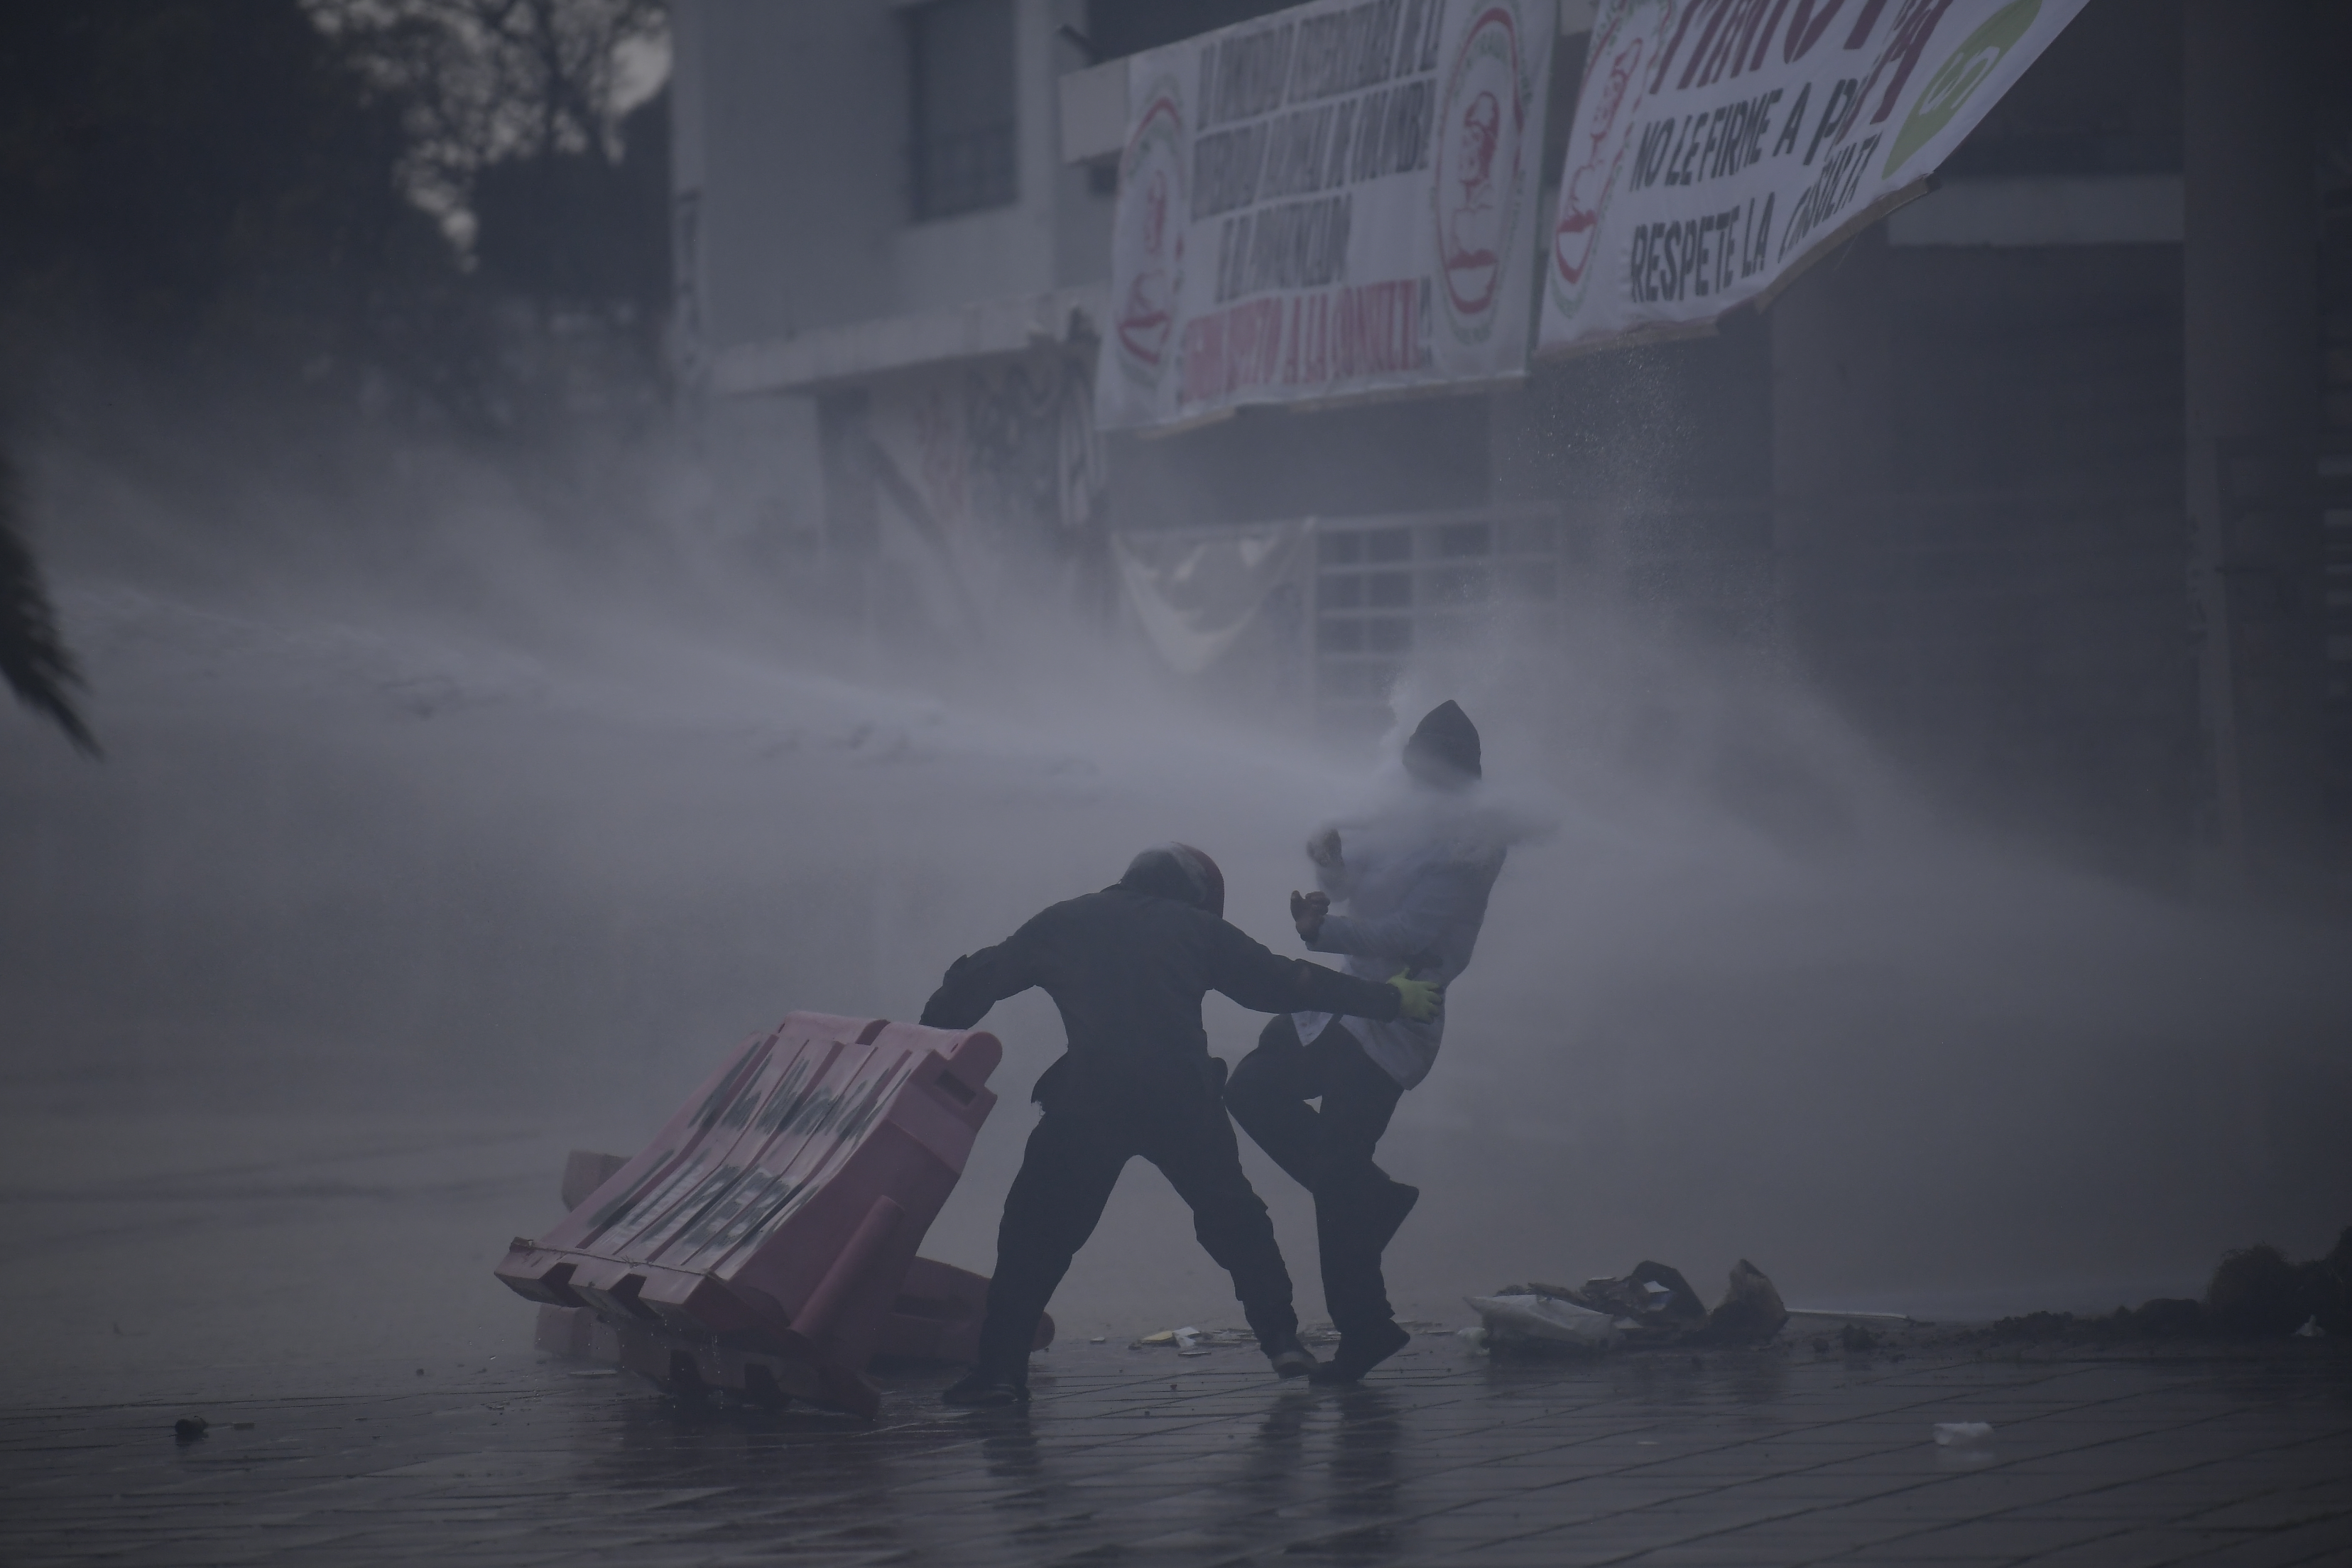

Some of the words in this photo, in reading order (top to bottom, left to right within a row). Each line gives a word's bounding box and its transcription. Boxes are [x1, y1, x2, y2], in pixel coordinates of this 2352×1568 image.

[1628, 117, 1675, 192] NO
[1664, 112, 1709, 186] LE
[1698, 87, 1783, 182] FIRME
[1772, 82, 1812, 157] A
[1631, 204, 1741, 303] RESPETE
[1741, 191, 1775, 278] LA
